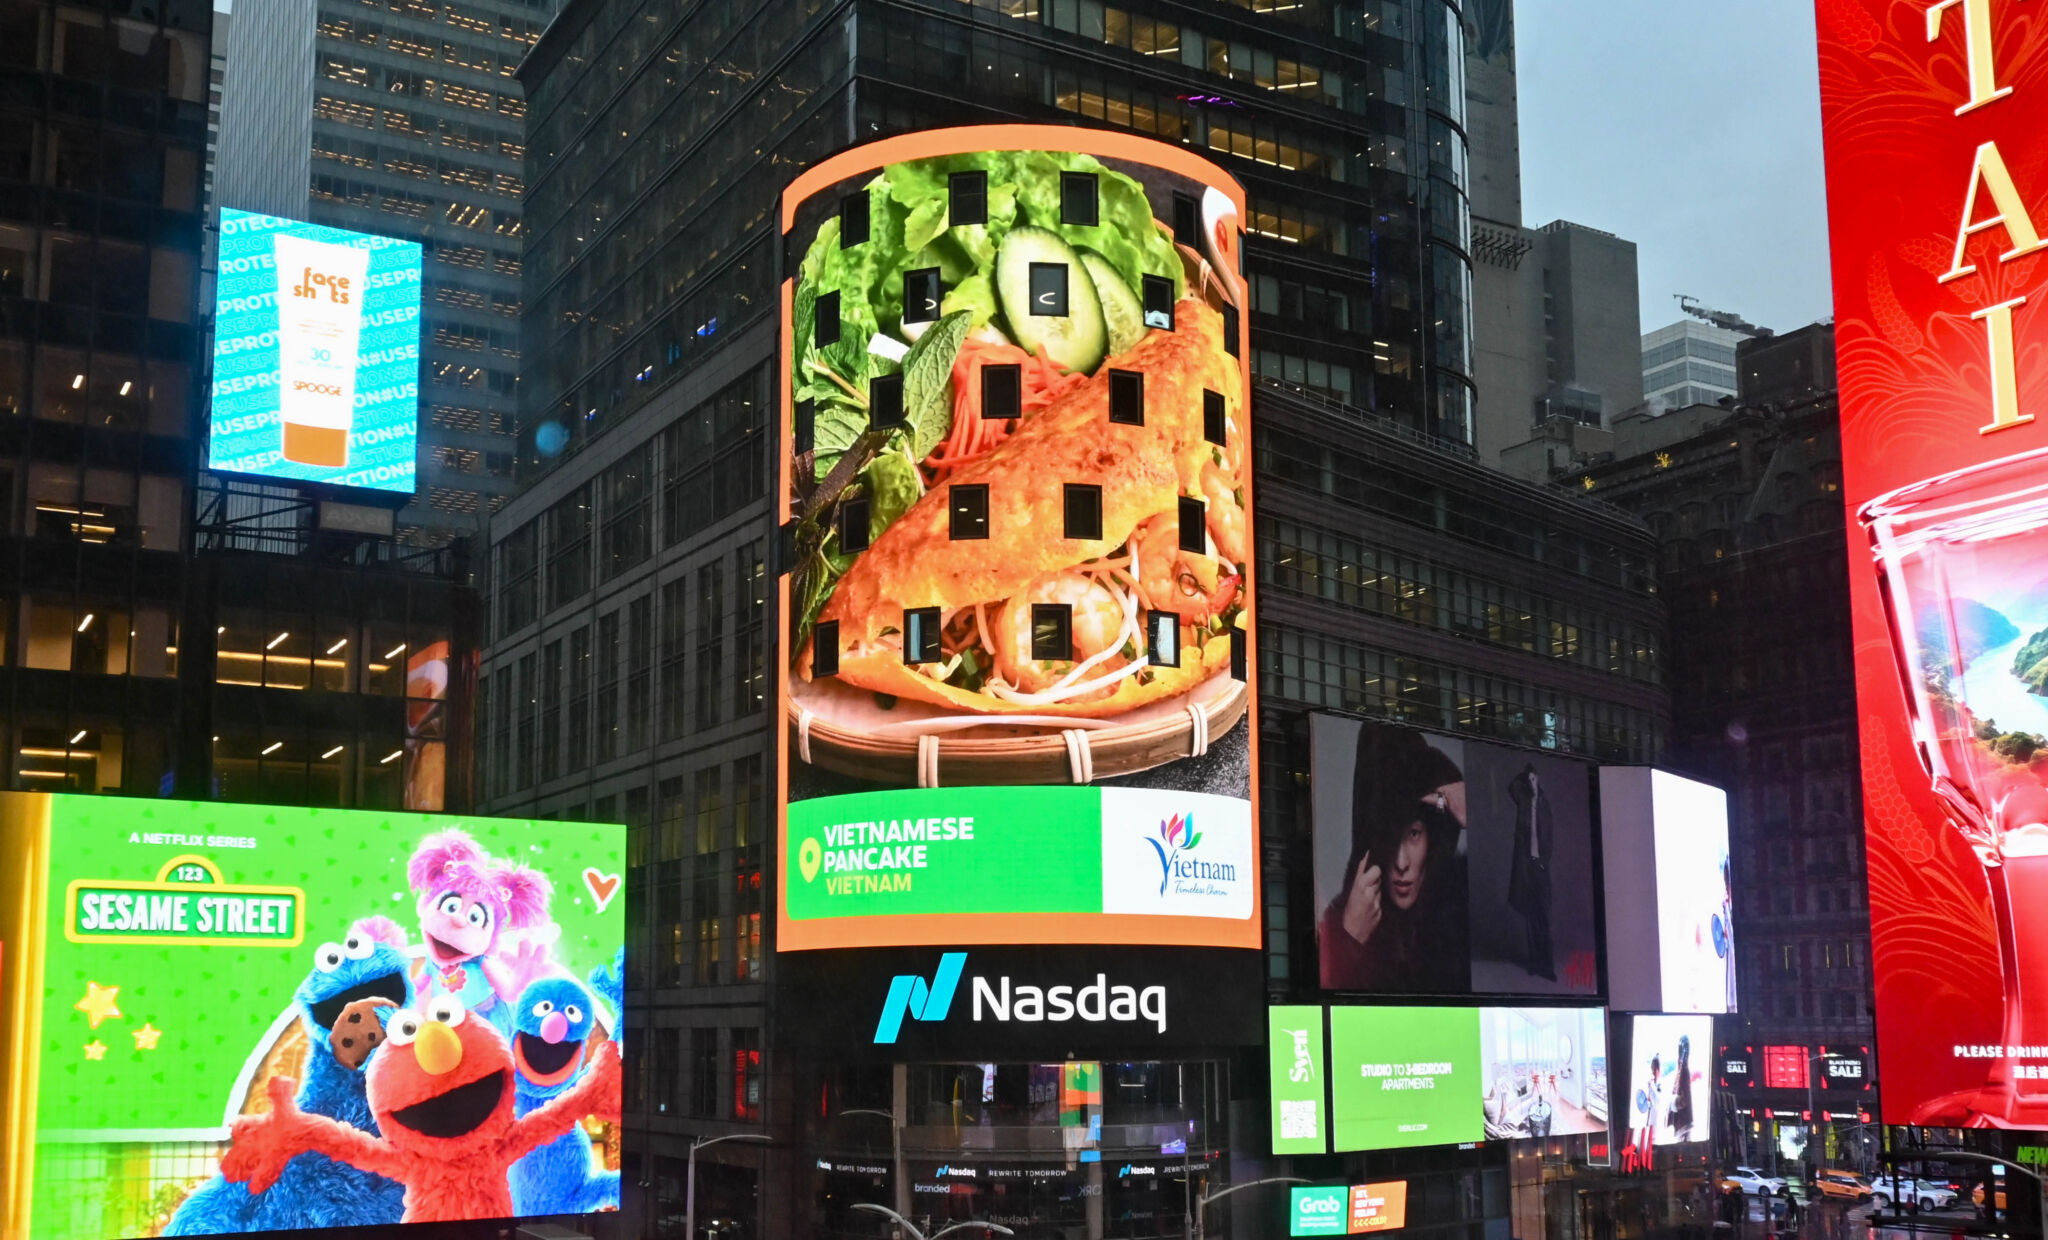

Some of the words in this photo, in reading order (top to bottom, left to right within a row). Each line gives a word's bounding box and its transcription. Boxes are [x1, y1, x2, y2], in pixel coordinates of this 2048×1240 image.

[304, 266, 350, 289] face
[310, 347, 330, 361] 30
[824, 817, 974, 847] VIETNAMESE
[128, 832, 141, 844] A
[143, 833, 204, 846] NETFLIX
[207, 835, 257, 848] SERIES
[824, 845, 928, 873] PANCAKE
[177, 867, 204, 881] 123
[1143, 837, 1236, 898] Vietnam
[826, 873, 912, 895] VIETNAM
[1175, 880, 1205, 894] Timeless
[81, 893, 188, 931] SESAME
[196, 896, 292, 934] STREET
[972, 973, 1167, 1034] Nasdaq
[1953, 1045, 2004, 1058] PLEASE
[1361, 1064, 1392, 1077] STUDIO
[1393, 1064, 1405, 1076] TO
[1829, 1065, 1862, 1077] SALE
[1381, 1077, 1435, 1090] APARTMENTS
[948, 1167, 976, 1178] Nasdaq
[1131, 1166, 1155, 1175] Nasdaq
[1299, 1195, 1340, 1213] Grab
